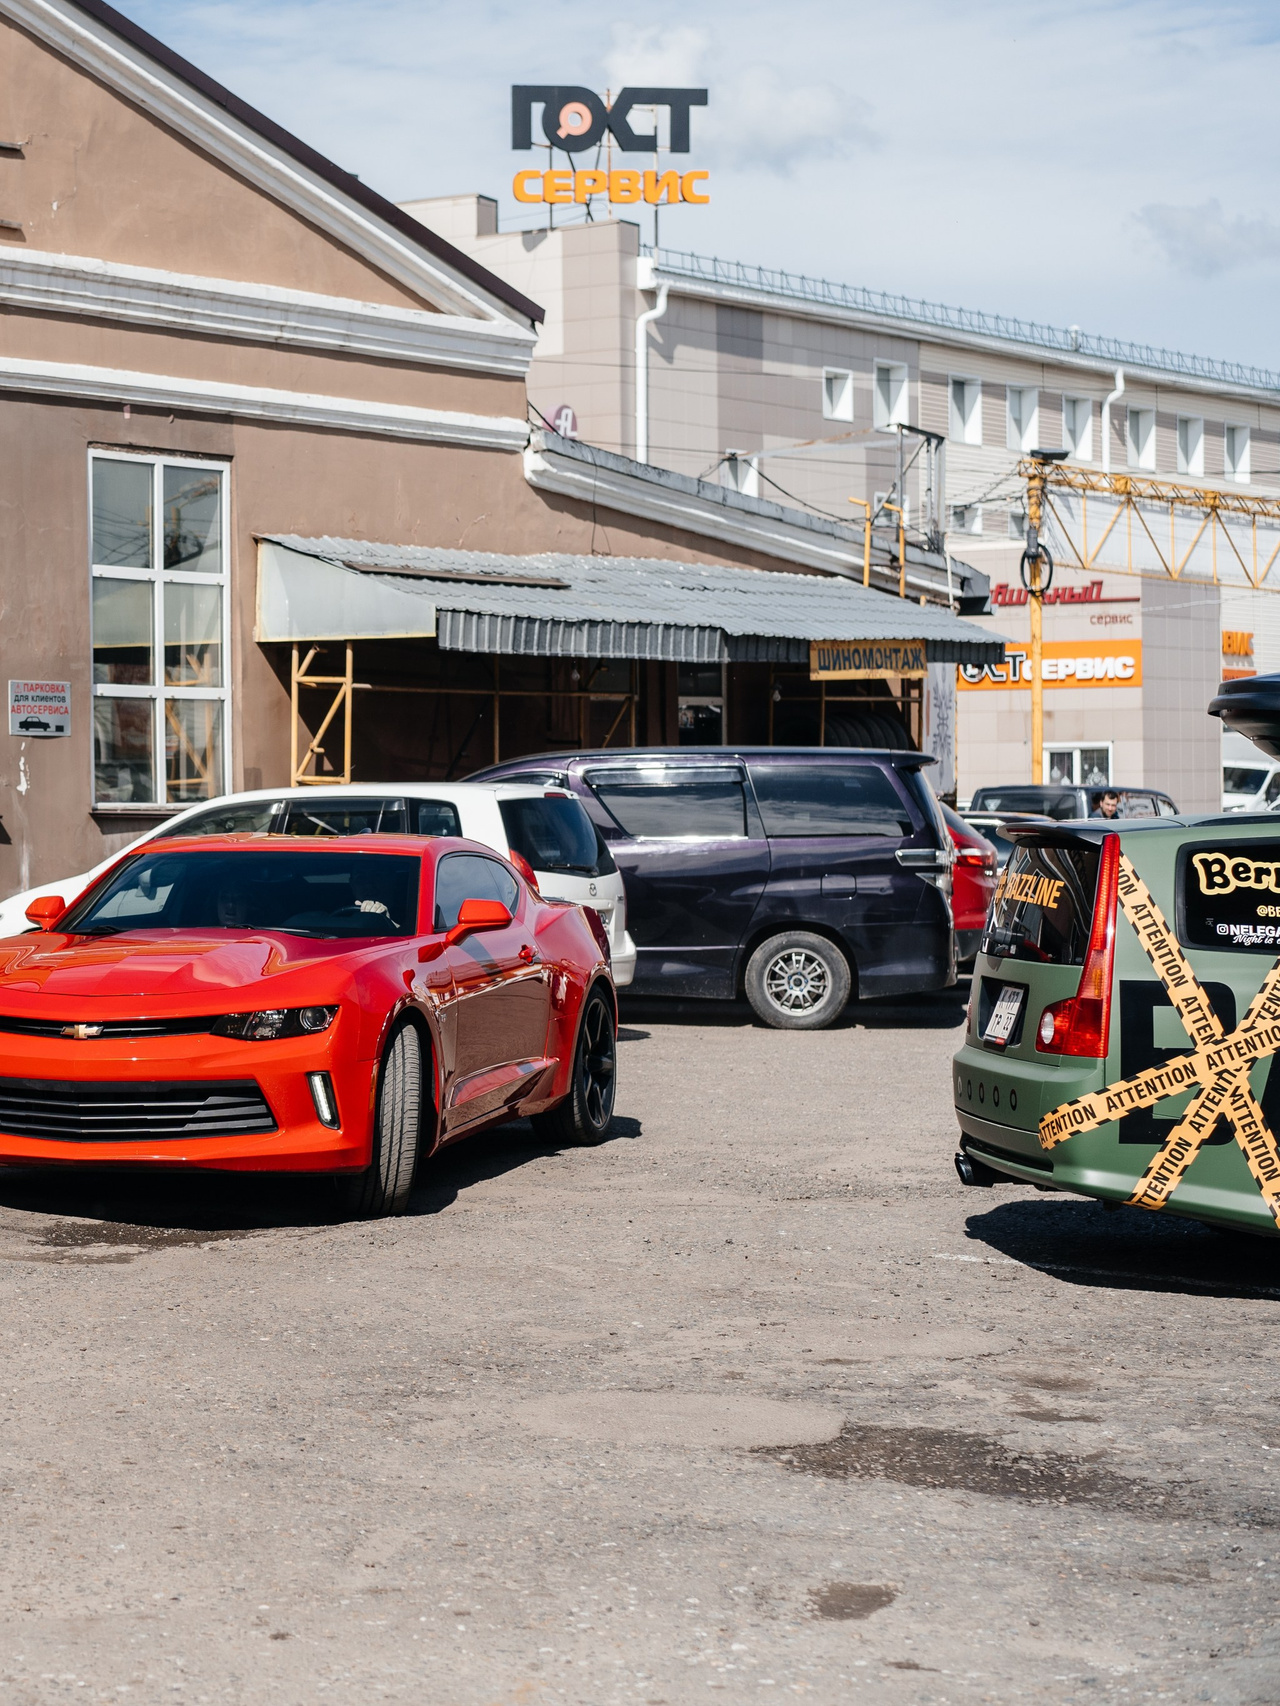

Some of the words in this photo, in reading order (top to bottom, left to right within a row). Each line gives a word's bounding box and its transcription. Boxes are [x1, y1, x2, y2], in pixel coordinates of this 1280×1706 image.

[513, 169, 710, 204] СЕРВИС
[1090, 614, 1133, 627] сервис
[818, 646, 924, 671] ШИНОМОНТАЖ
[14, 694, 29, 703] для
[31, 695, 66, 703] клиентов
[23, 683, 66, 694] ПАРКОВКА
[11, 704, 69, 716] АВТОСЕРВИСА
[1130, 902, 1189, 989] ATTENTION
[1105, 1061, 1197, 1113] ATTENTION
[1039, 1103, 1097, 1145] ATTENTION
